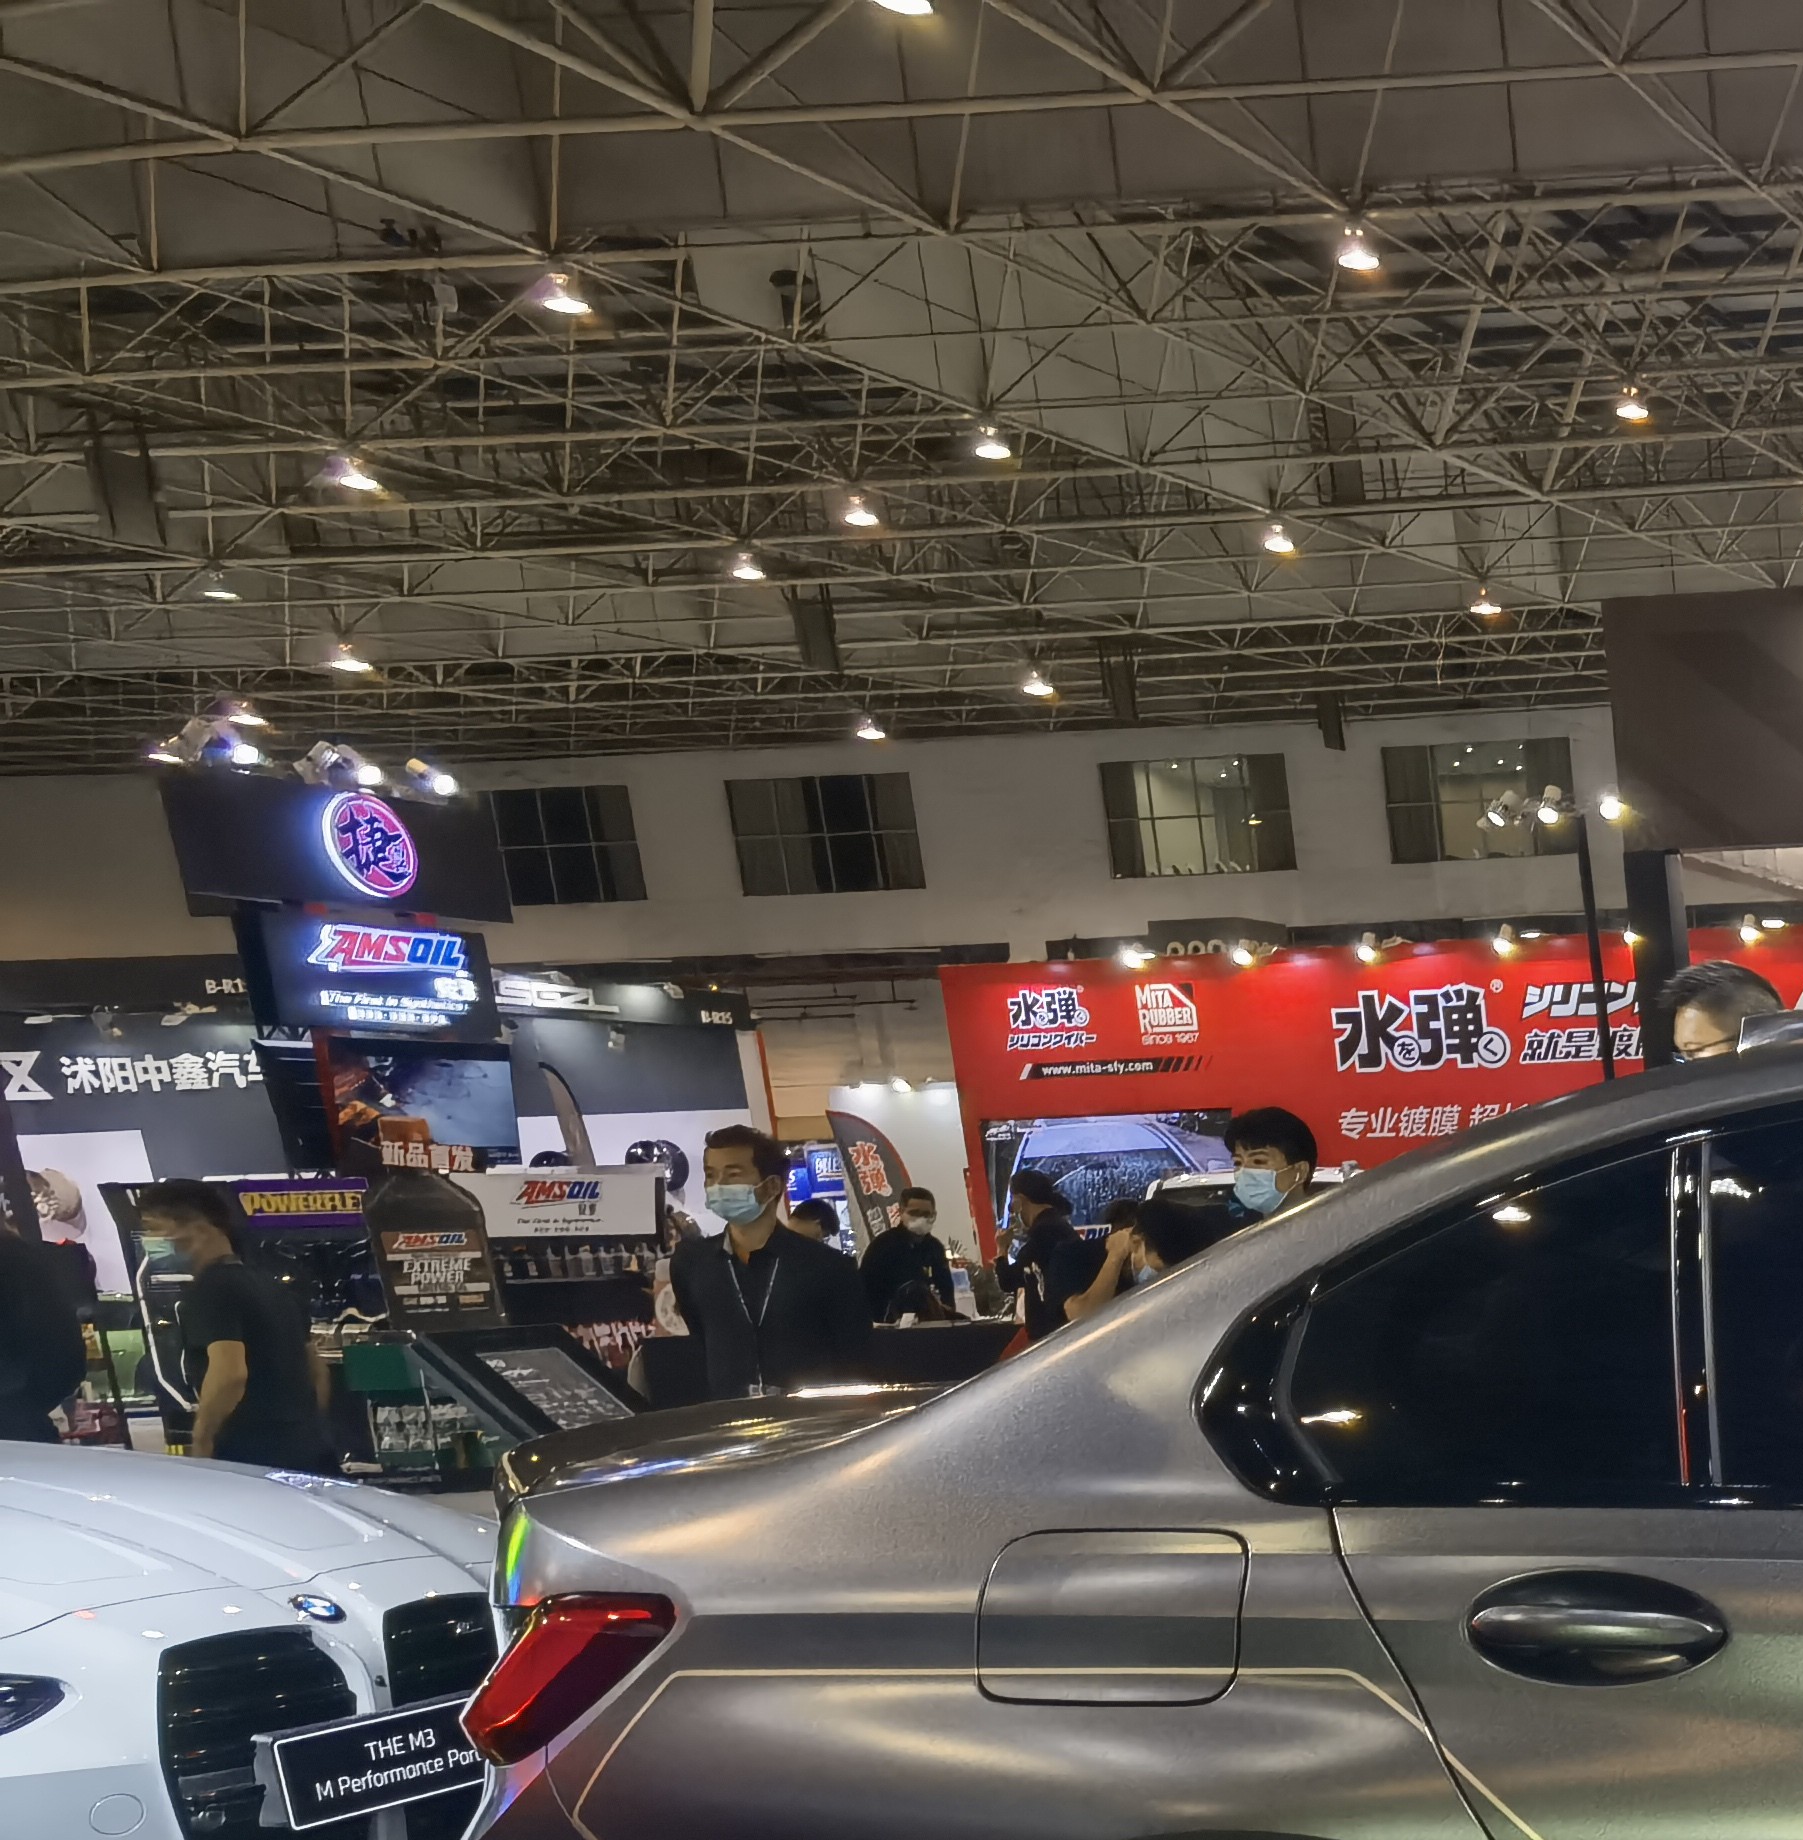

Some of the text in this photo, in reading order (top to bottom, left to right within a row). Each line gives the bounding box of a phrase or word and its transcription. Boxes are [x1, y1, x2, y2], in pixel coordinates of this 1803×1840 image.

[316, 926, 466, 970] AMSOIL
[1522, 981, 1639, 1019] シリコン
[1338, 1104, 1461, 1140] 专业镀膜
[381, 1140, 475, 1172] 新品首发
[240, 1192, 362, 1216] POWERFLE
[516, 1180, 600, 1205] AMSOIL
[403, 1258, 471, 1273] EXTREME
[410, 1270, 464, 1285] POWER
[364, 1728, 436, 1762] THE M3
[315, 1781, 334, 1802] M
[338, 1757, 444, 1796] Performance
